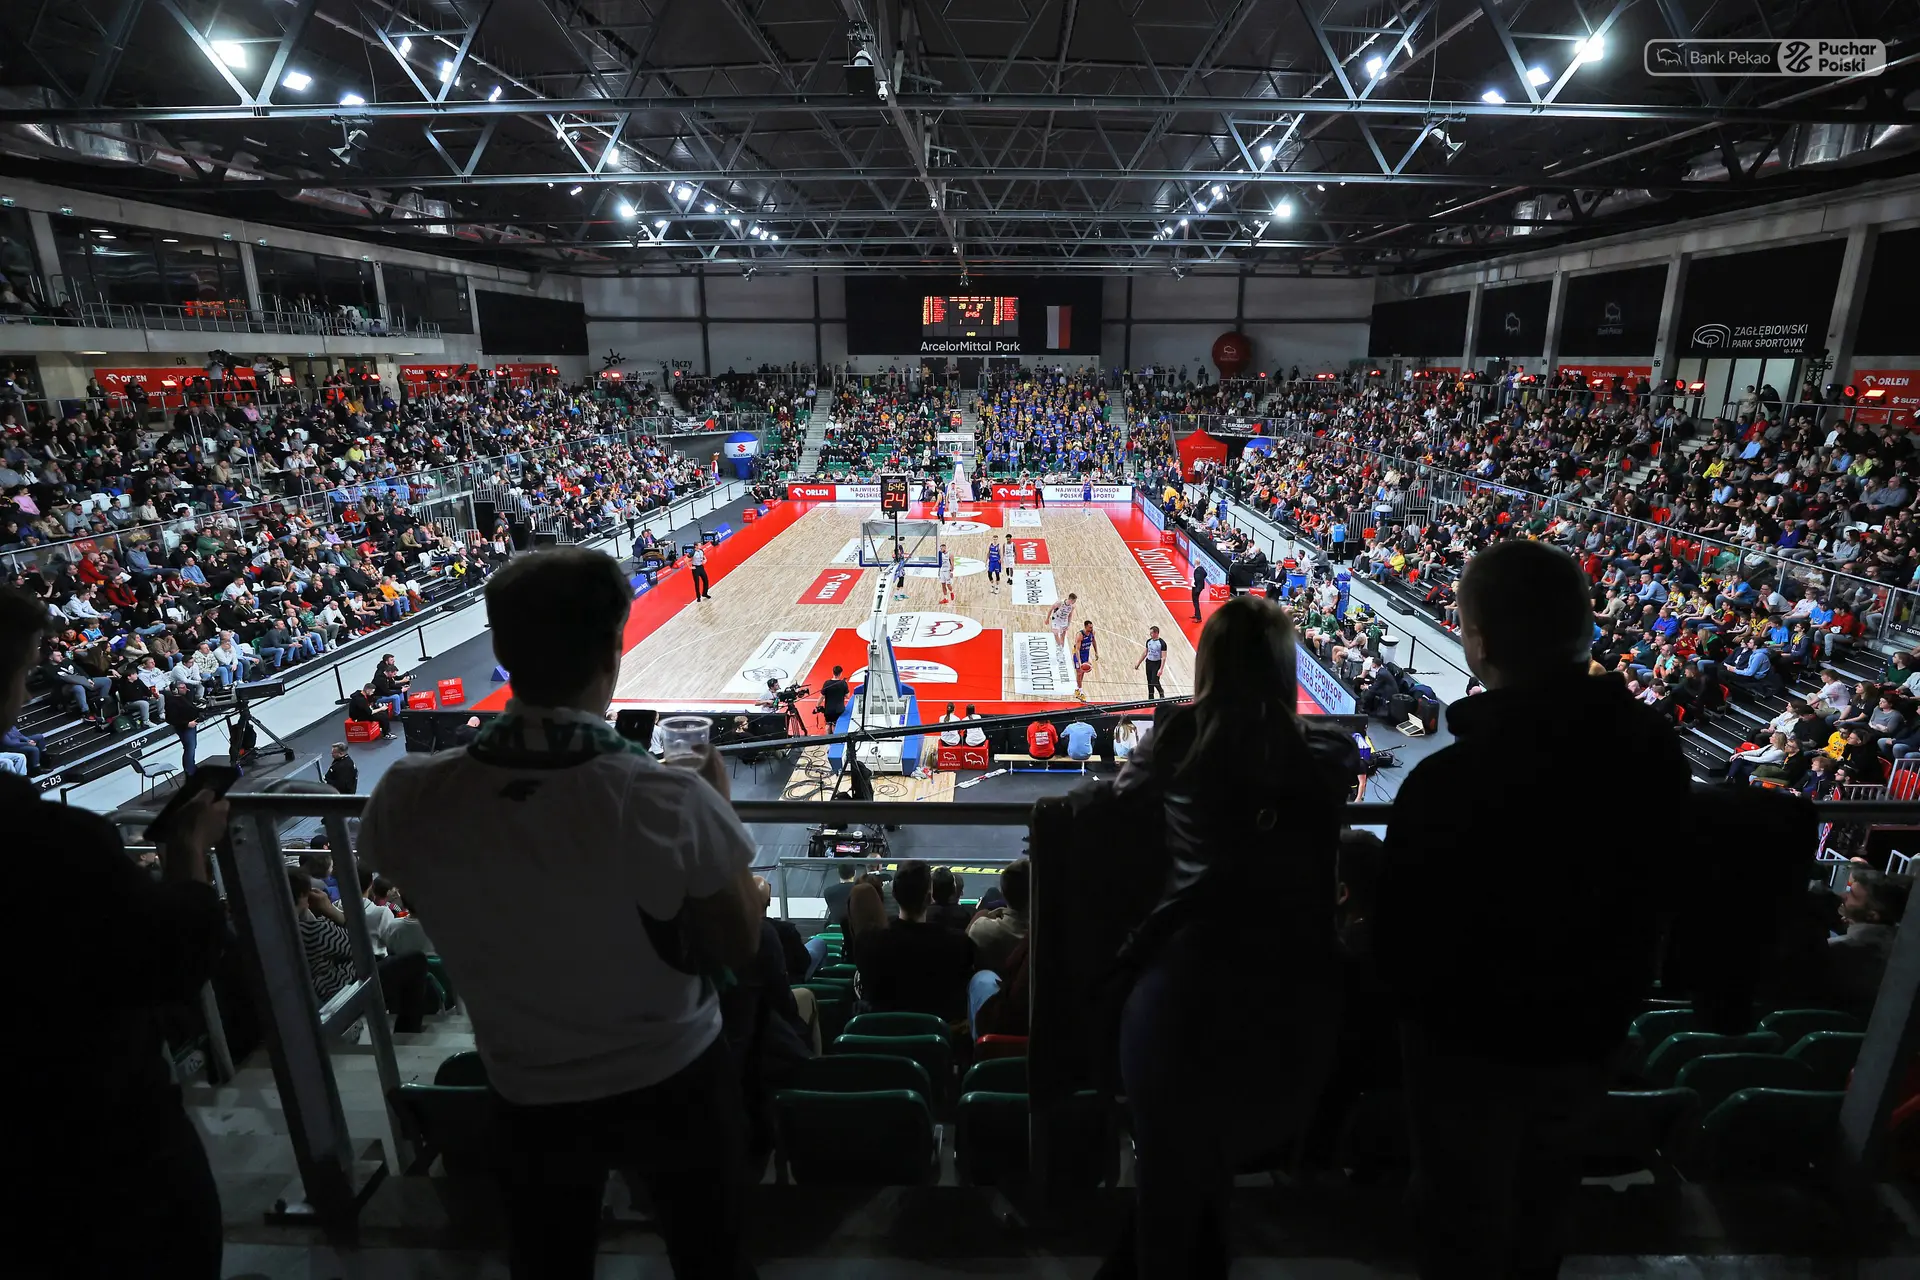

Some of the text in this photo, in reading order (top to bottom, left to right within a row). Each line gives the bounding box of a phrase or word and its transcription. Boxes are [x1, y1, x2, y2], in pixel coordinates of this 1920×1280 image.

[1733, 323, 1809, 338] ZAGŁĘBIOWSKI
[920, 341, 1021, 352] ArcelorMittal Park
[1731, 337, 1806, 349] PARK SPORTOWY
[175, 356, 188, 366] D5
[671, 359, 693, 370] łączy
[120, 374, 147, 383] OREN
[1877, 377, 1909, 386] ORLEN
[805, 488, 829, 497] ORLEN
[887, 482, 906, 491] 6:45
[883, 492, 906, 509] 24
[815, 581, 843, 600] ORLEN
[1025, 579, 1043, 605] Bank Pekao
[896, 615, 914, 627] Bank
[1027, 635, 1055, 691] AEROWATCH
[1314, 665, 1343, 703] SPONSOR
[1314, 682, 1336, 711] SPORTU
[130, 740, 141, 749] D4
[49, 774, 62, 786] D3
